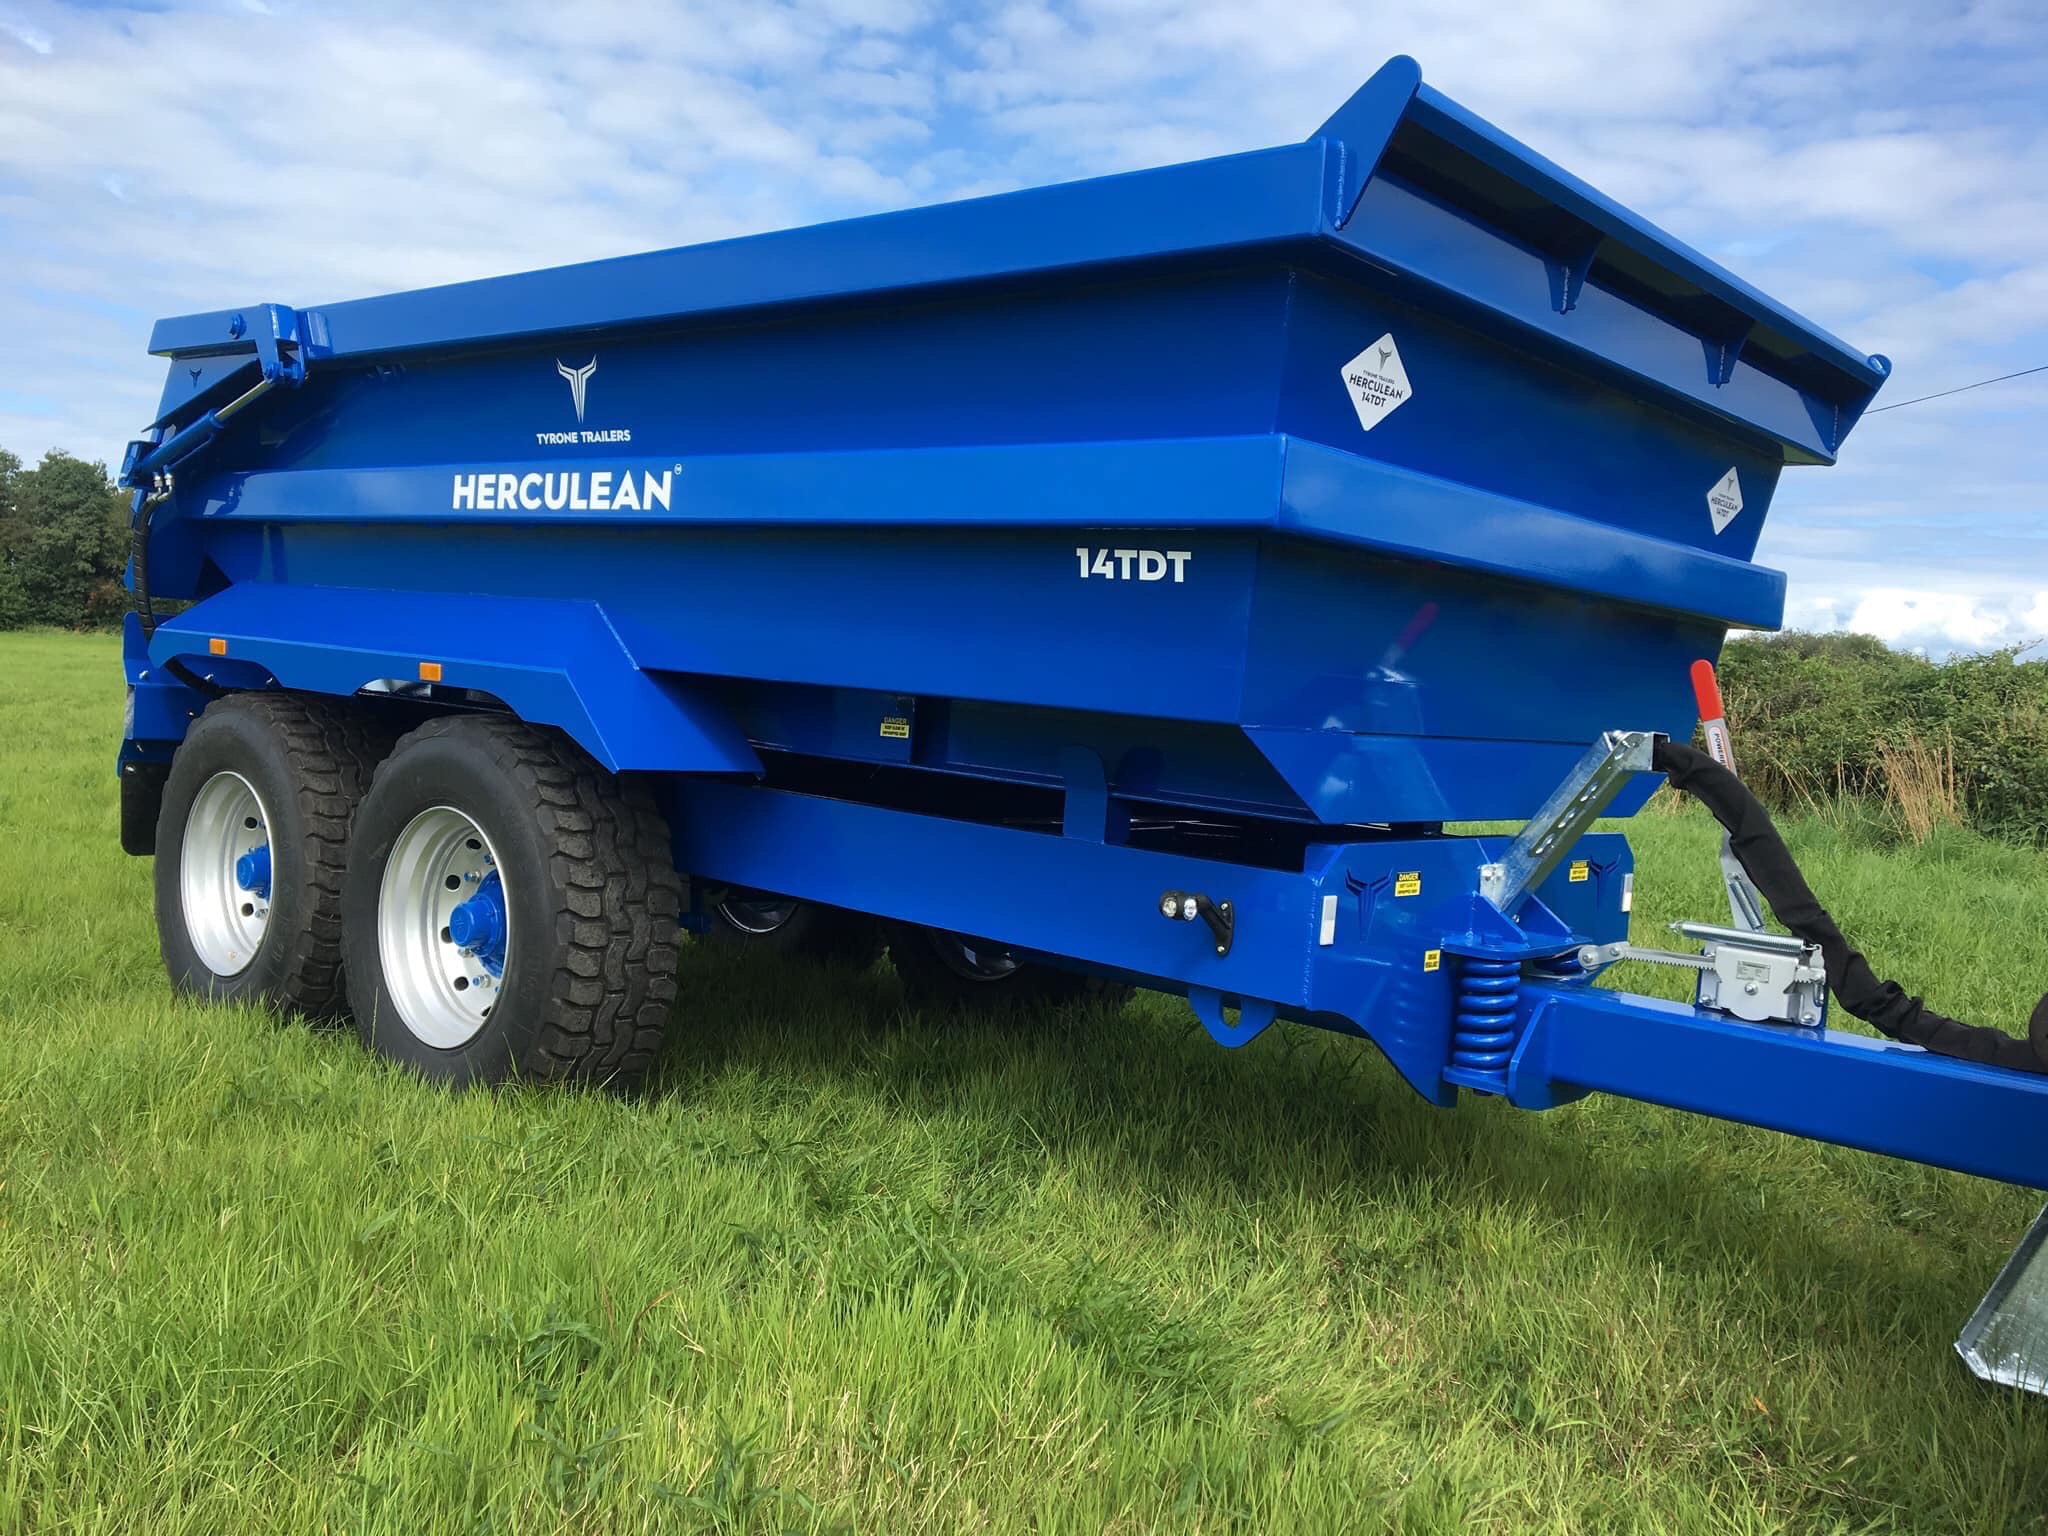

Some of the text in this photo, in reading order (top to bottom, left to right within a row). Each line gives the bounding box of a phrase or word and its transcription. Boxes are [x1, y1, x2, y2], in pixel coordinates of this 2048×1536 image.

[1349, 373, 1404, 400] HERCULEAN
[1361, 391, 1387, 407] 14TDT
[536, 429, 632, 446] TYRONE TRAILERS
[1076, 547, 1192, 583] 14TDT
